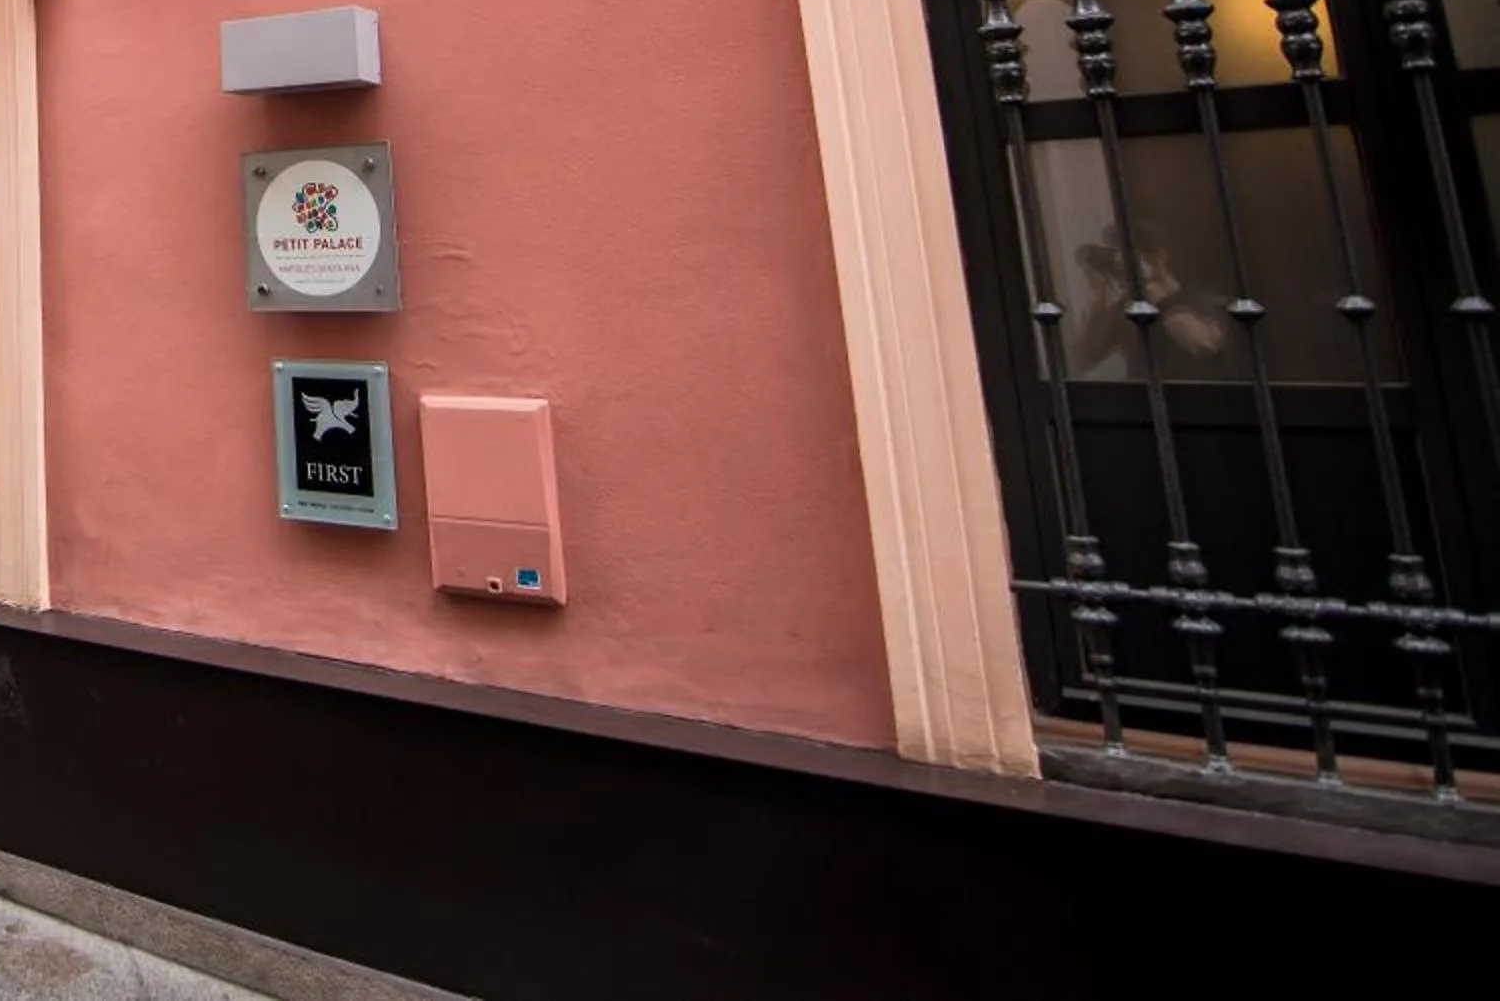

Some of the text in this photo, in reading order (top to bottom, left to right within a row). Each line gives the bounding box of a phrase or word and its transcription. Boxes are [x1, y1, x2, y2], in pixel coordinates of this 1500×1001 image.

[274, 236, 363, 252] PETIT PALACE
[306, 462, 363, 486] FIRST
